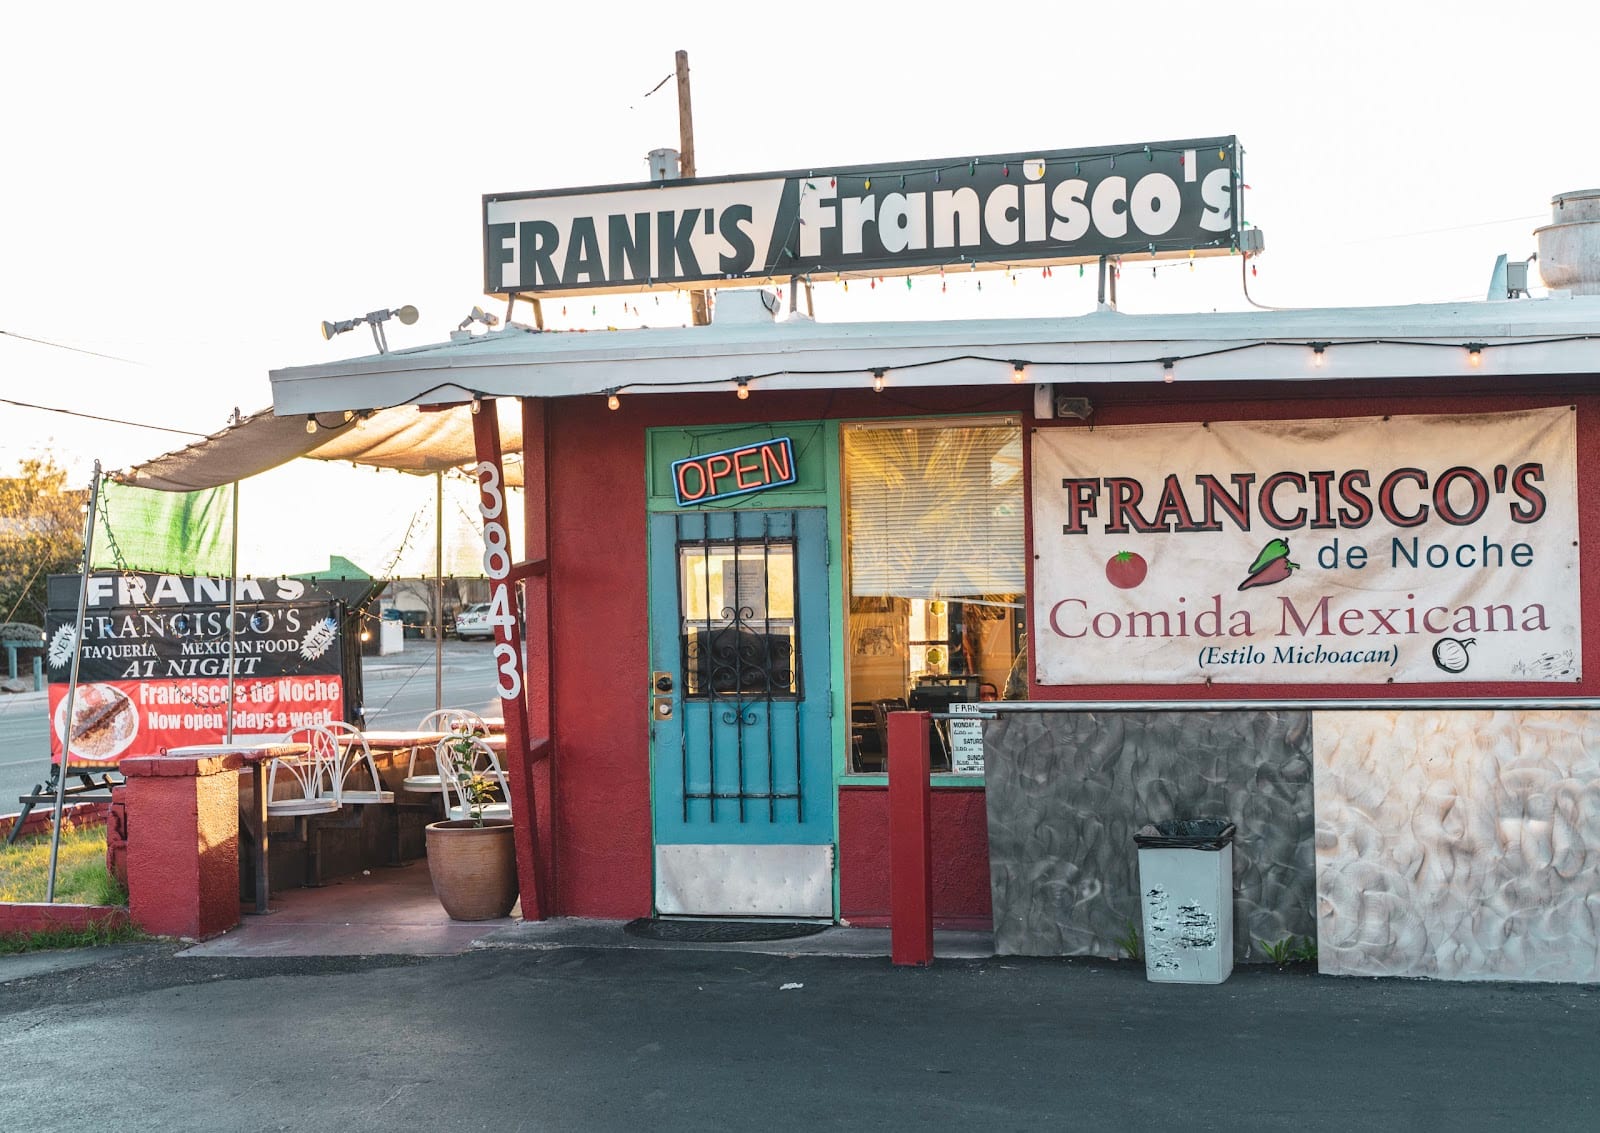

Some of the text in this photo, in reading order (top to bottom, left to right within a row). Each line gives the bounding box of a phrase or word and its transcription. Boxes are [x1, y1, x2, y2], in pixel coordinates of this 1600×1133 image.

[488, 149, 1231, 287] FRANK'S Francisco's
[678, 442, 790, 500] OPEN
[1062, 463, 1546, 535] FRANCISCO'S
[1317, 536, 1534, 570] de Noche
[87, 576, 304, 606] FRANKS
[477, 461, 521, 700] 3843
[81, 609, 300, 640] FRANCISCO'S
[1049, 594, 1550, 639] Comida Mexicana
[54, 631, 73, 660] NEW
[182, 641, 252, 655] MEXICAN
[256, 639, 299, 653] FOOD
[306, 624, 331, 656] NEW
[1198, 643, 1399, 668] (Estilo Michoacan)
[121, 656, 261, 678] AT NIGHT
[140, 680, 340, 704] Francisco's de Noche
[148, 712, 181, 729] Now
[184, 714, 223, 731] open
[277, 713, 287, 728] a
[290, 708, 332, 727] week
